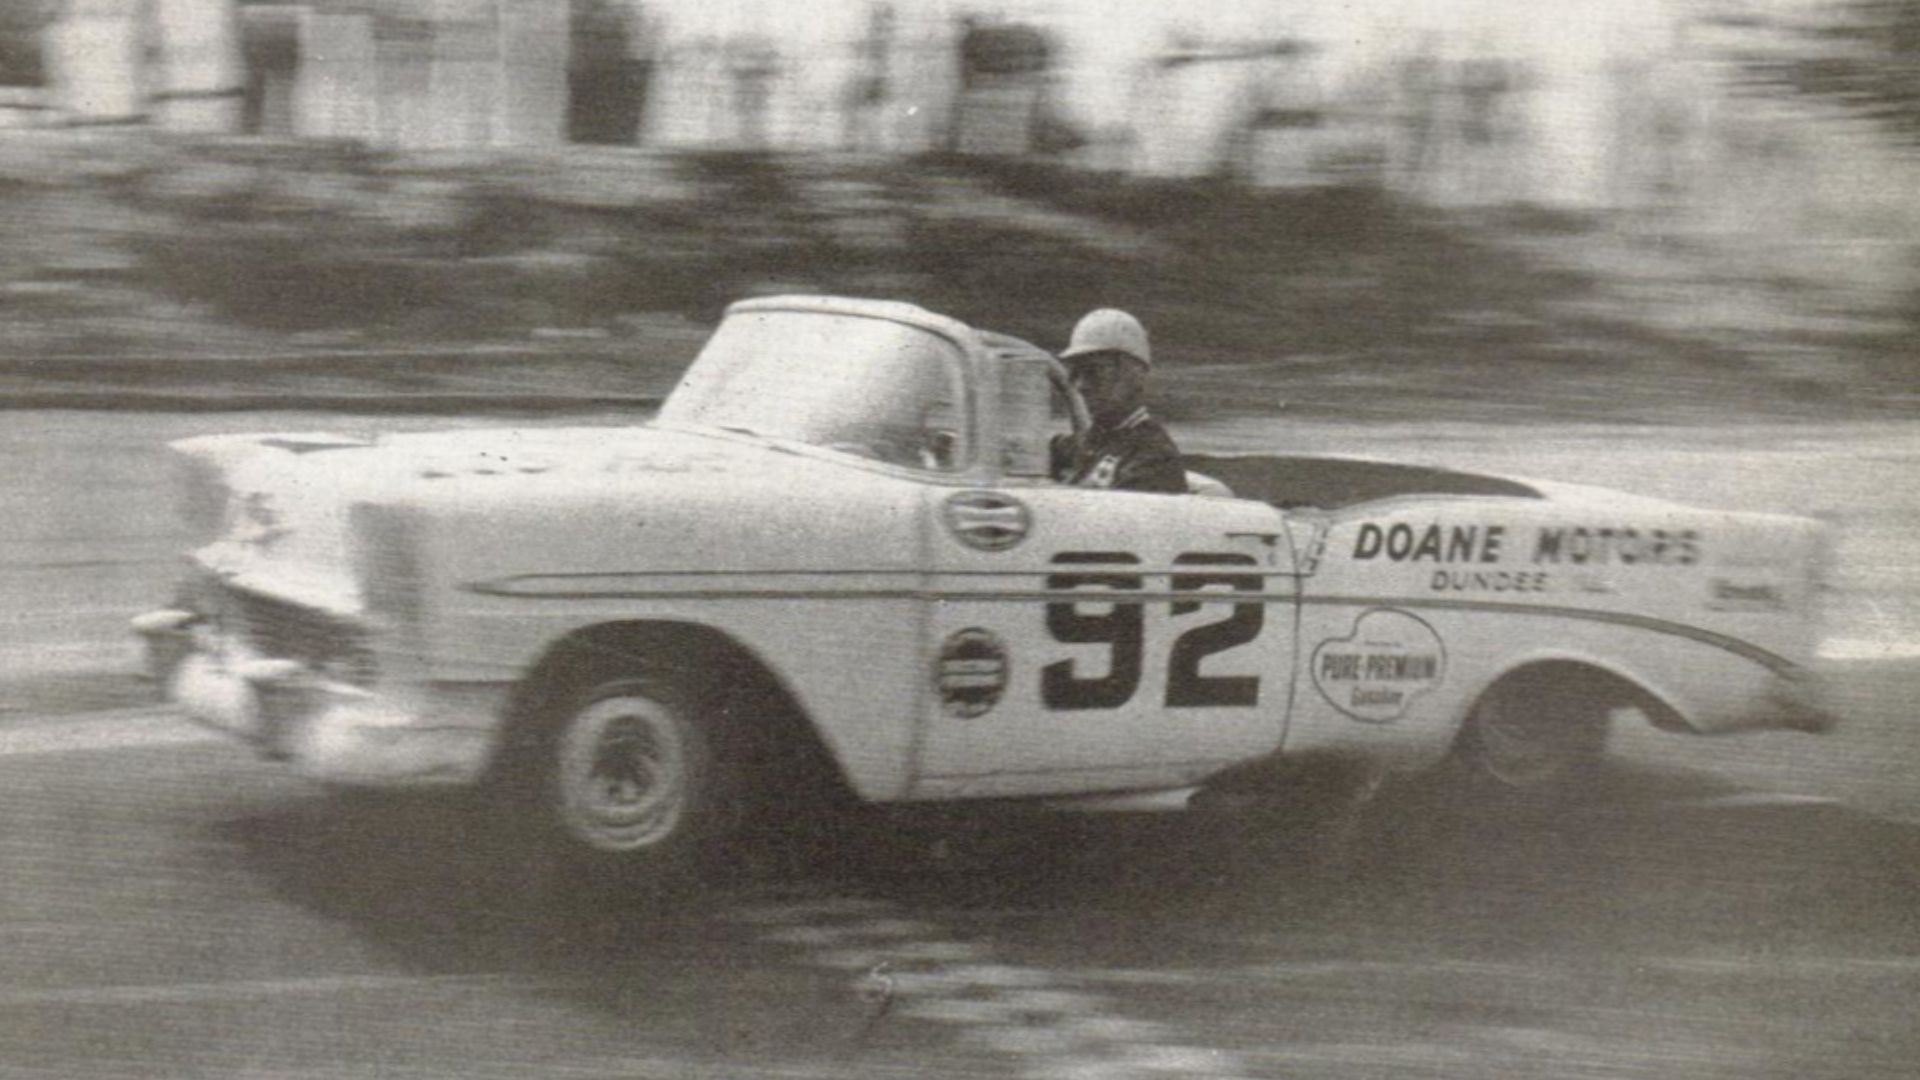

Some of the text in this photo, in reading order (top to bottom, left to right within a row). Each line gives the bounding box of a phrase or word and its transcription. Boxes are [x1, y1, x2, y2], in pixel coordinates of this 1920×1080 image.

[1354, 522, 1701, 566] DOANE MOTORS
[1430, 570, 1548, 592] DUNDEE
[1040, 551, 1264, 709] 92
